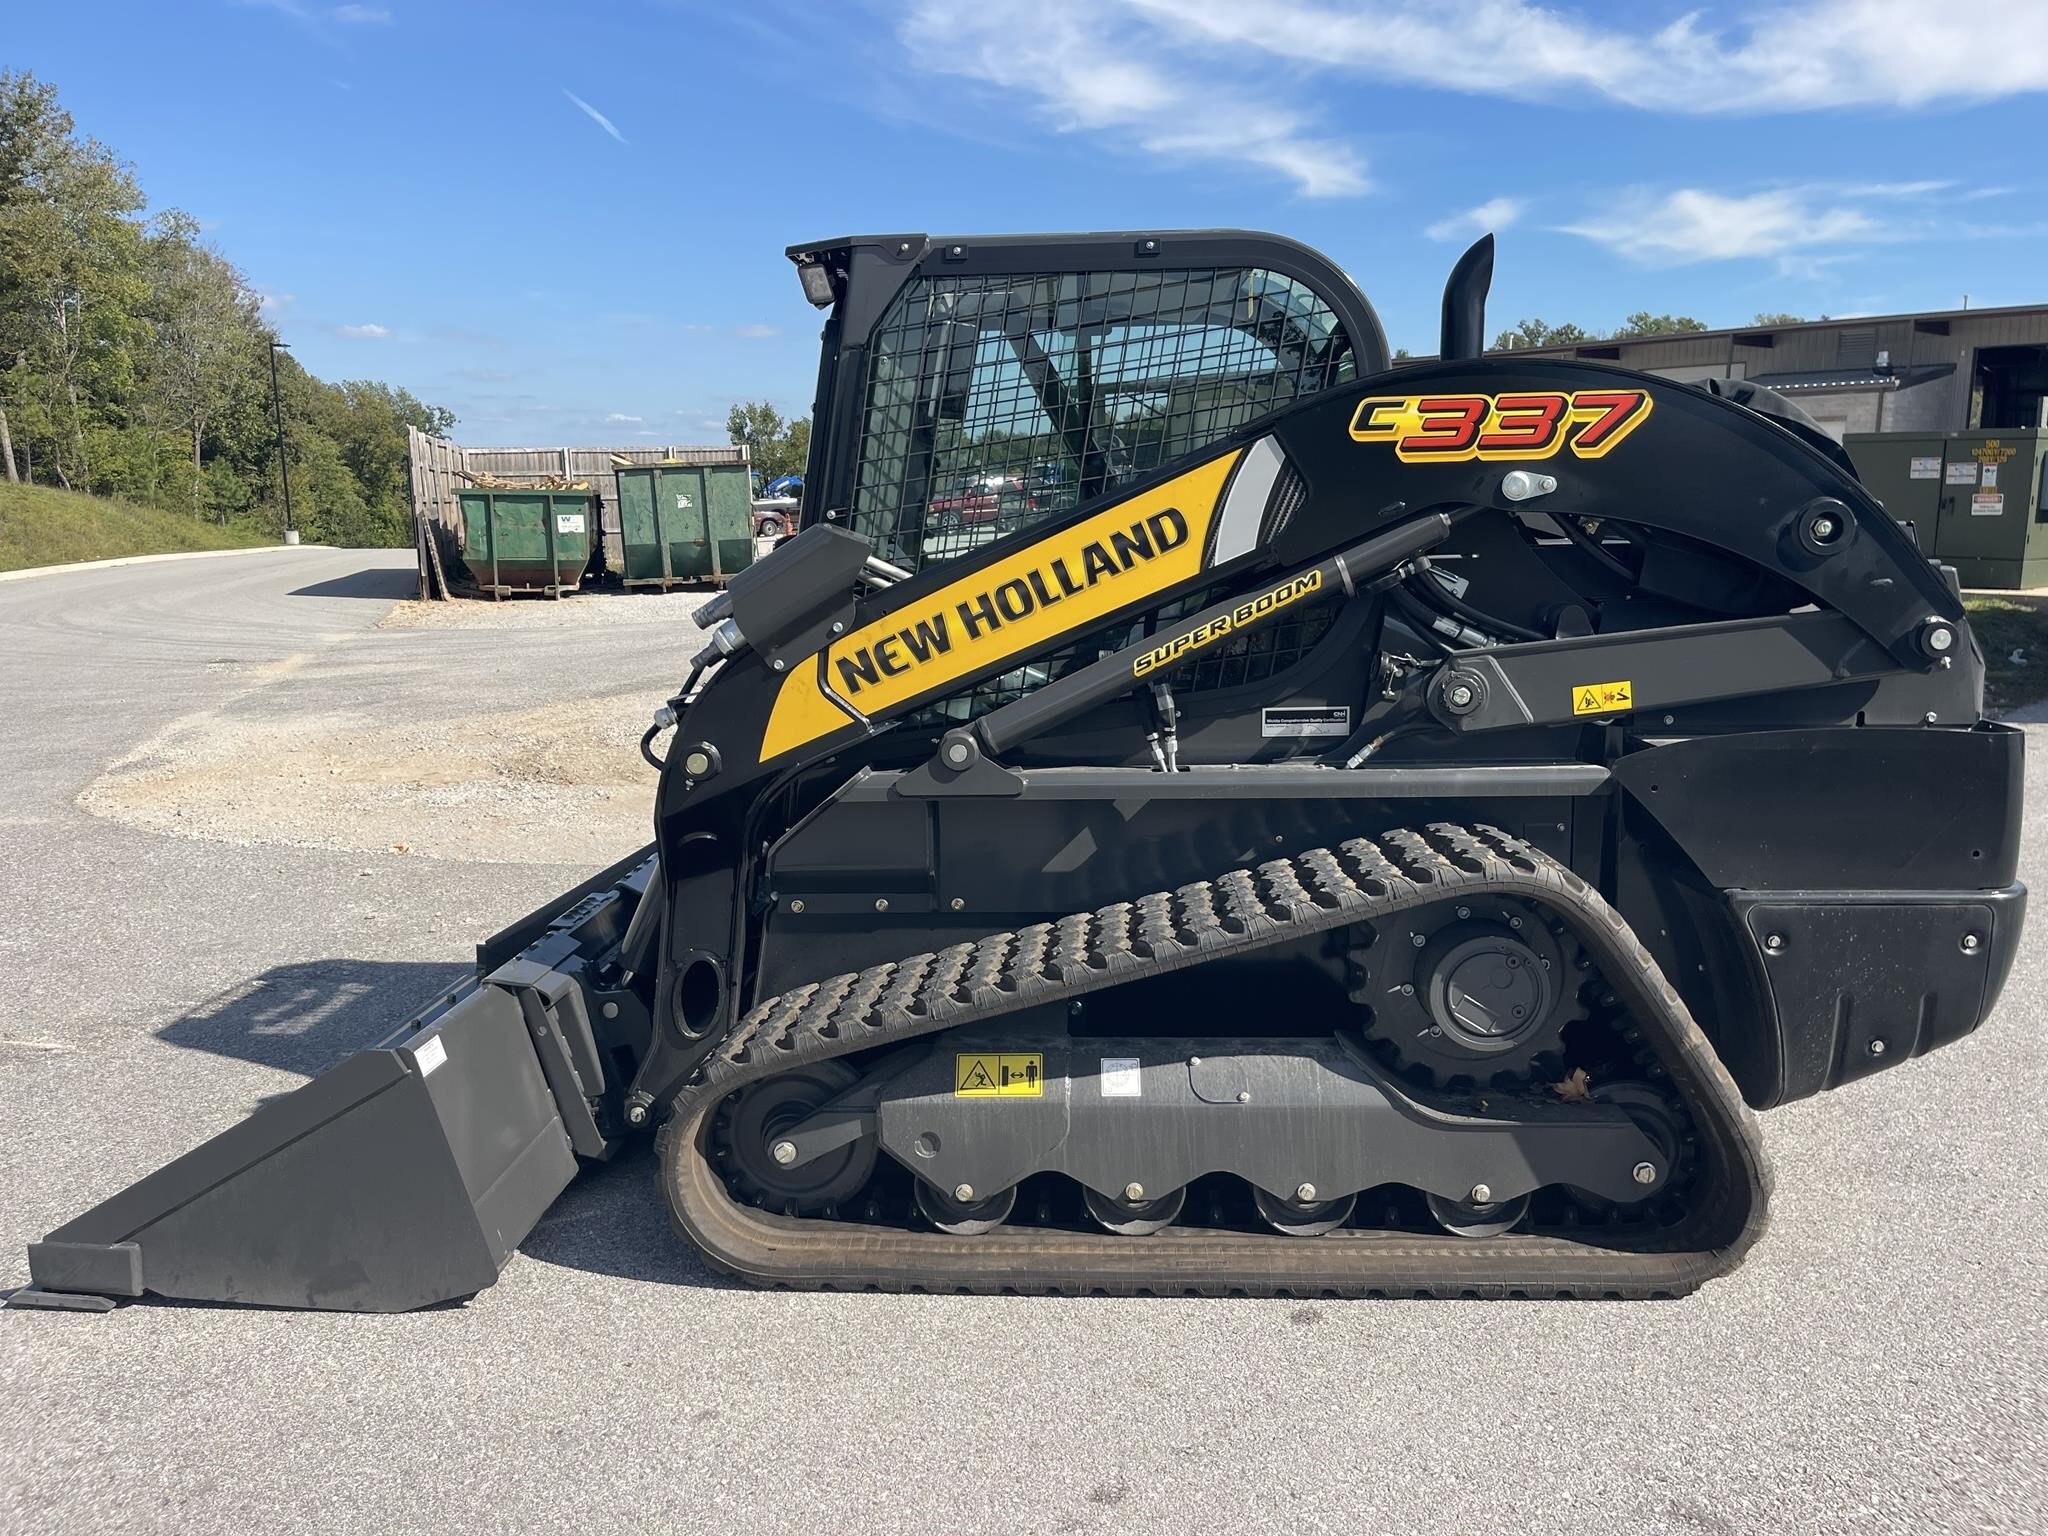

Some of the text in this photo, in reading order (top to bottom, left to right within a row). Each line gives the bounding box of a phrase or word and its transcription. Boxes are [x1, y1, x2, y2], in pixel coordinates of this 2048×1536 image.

[1350, 390, 1652, 462] C337
[834, 507, 1190, 695] NEW HOLLAND
[1133, 569, 1321, 677] SUPER BOOM
